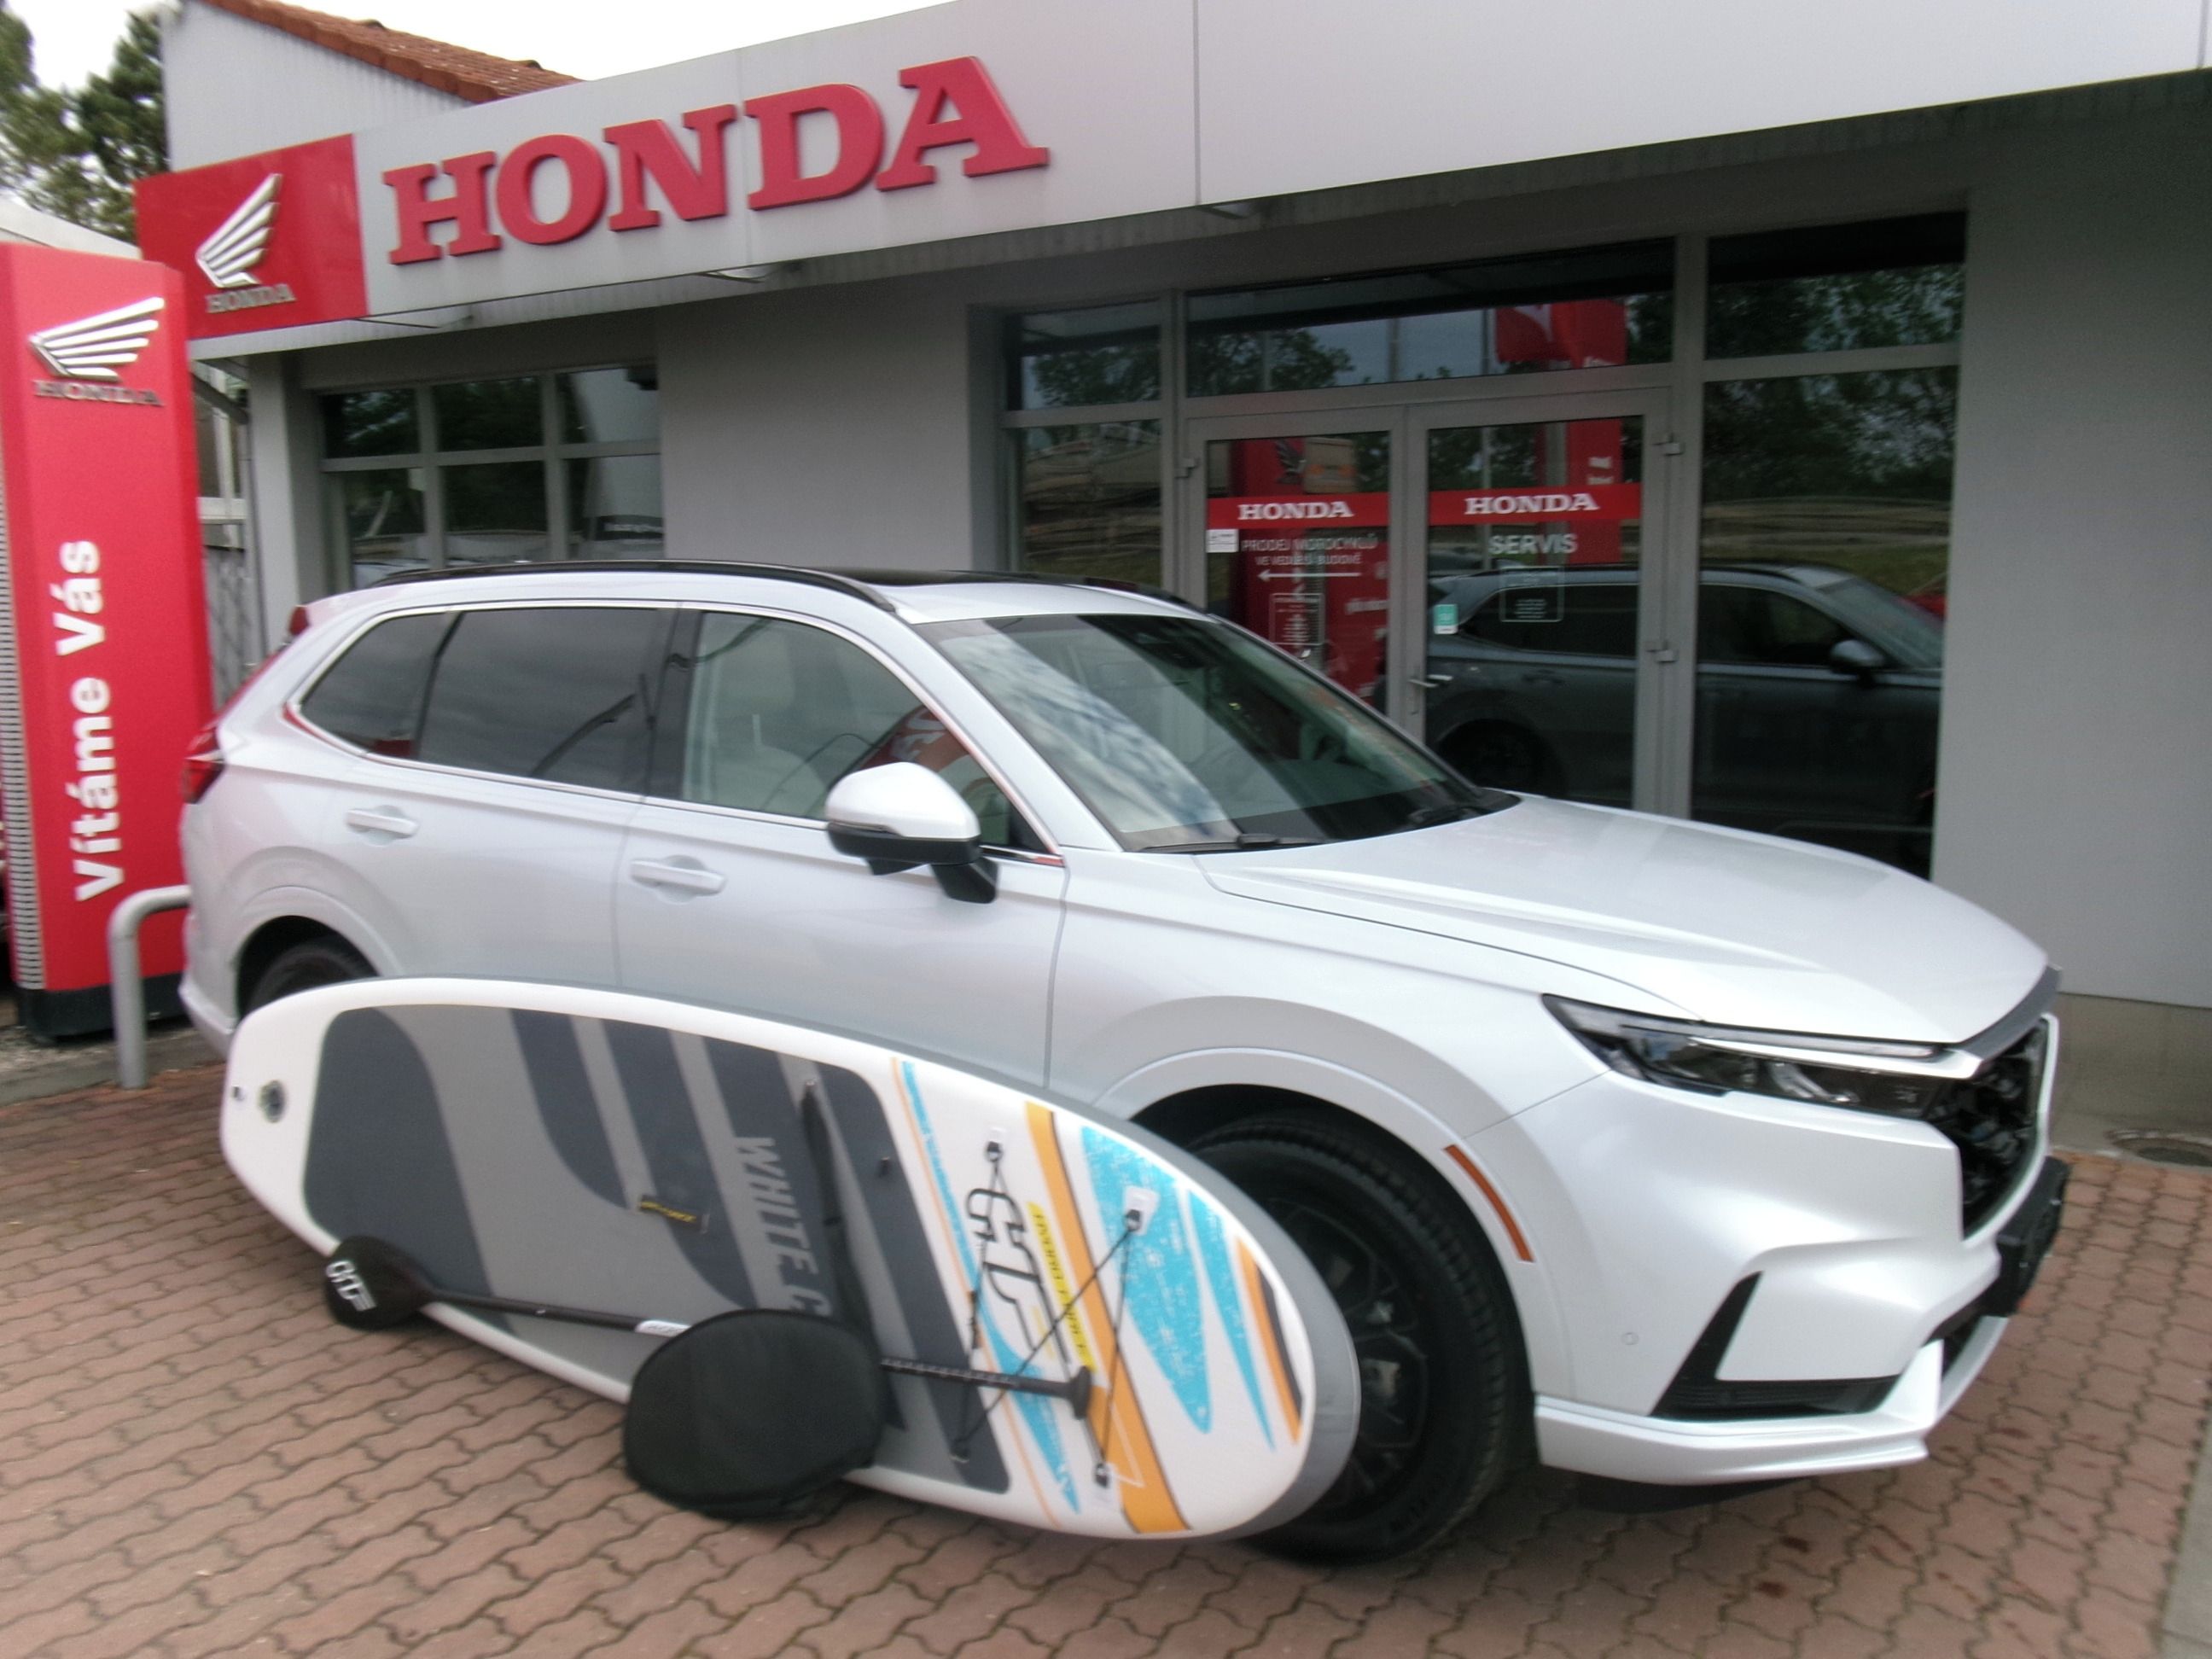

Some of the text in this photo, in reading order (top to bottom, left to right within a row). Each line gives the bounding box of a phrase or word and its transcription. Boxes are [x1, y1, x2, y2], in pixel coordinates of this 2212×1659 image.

[382, 55, 1050, 266] HONDA
[205, 282, 296, 314] HONDA
[33, 378, 164, 407] HONDA
[1237, 500, 1355, 521] HONDA
[1464, 492, 1600, 516] HONDA
[1488, 533, 1578, 555] SERVIS
[49, 539, 125, 902] Vítáme Vás
[734, 1137, 819, 1275] WHITE
